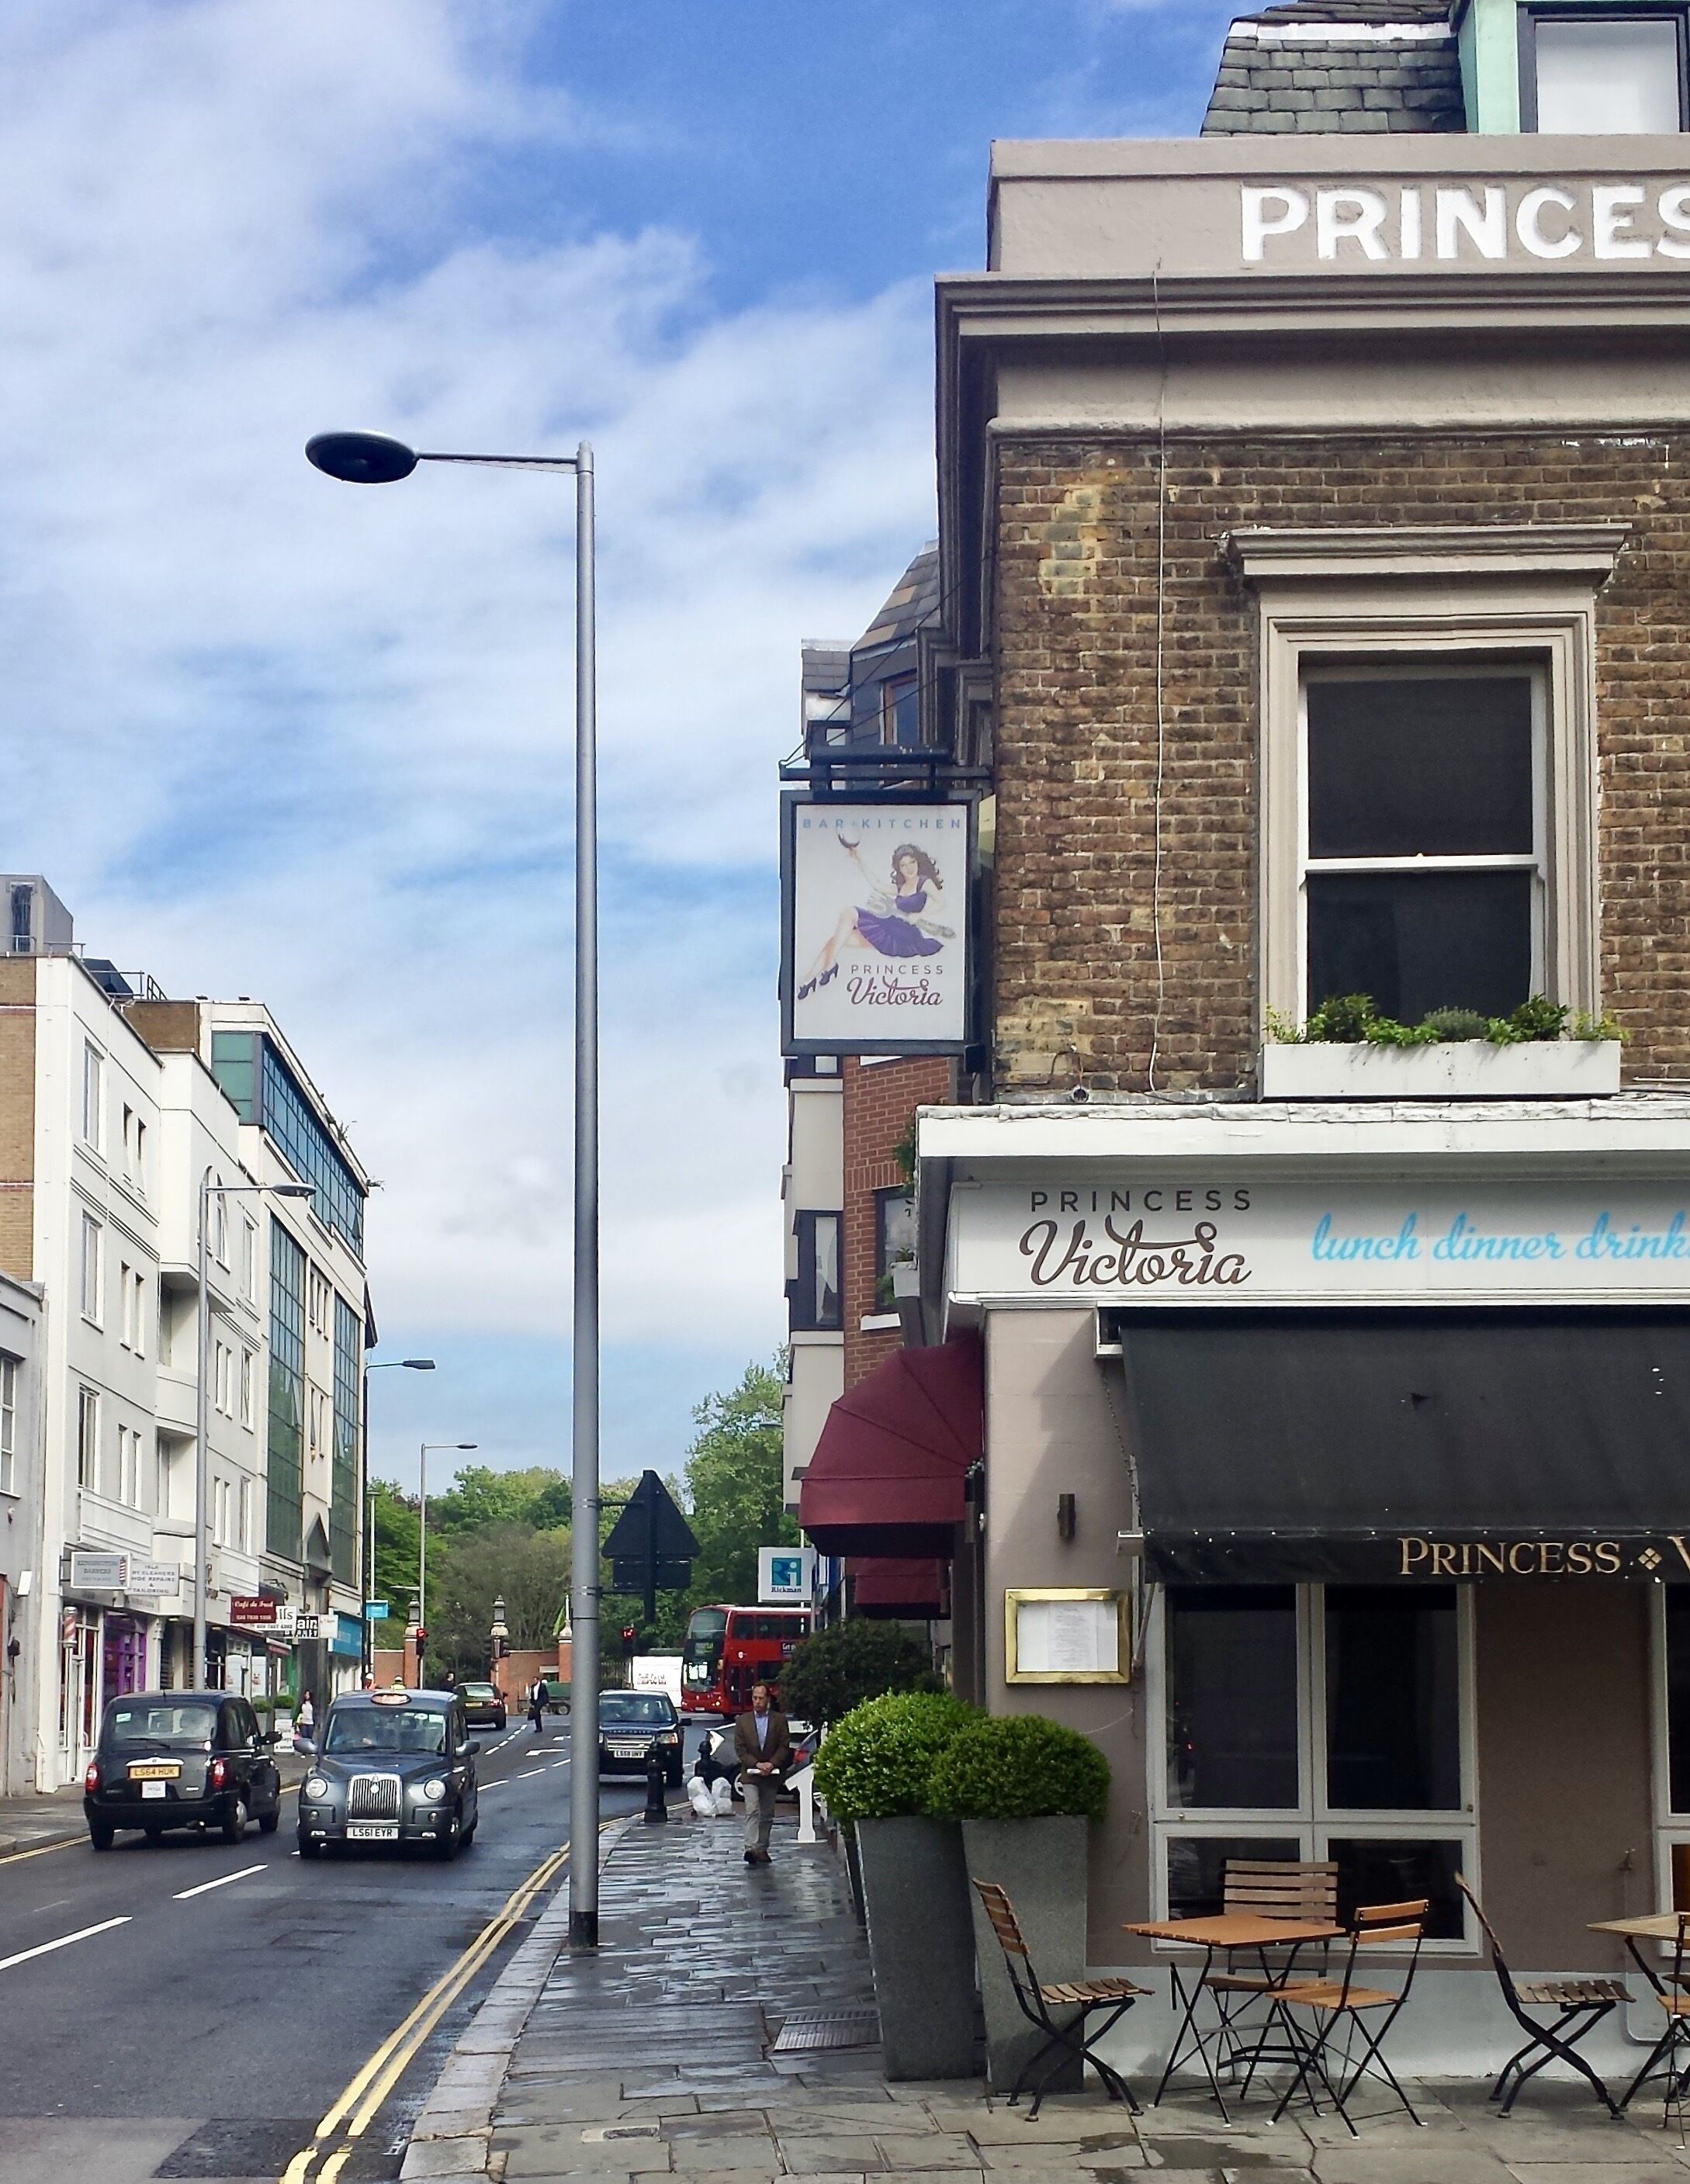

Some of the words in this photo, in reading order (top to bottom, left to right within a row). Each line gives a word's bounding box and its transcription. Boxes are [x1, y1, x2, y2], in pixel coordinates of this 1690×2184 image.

[802, 819, 845, 829] BAR
[861, 819, 961, 829] KITCHEN
[851, 964, 944, 974] PRINCESS
[846, 975, 944, 1005] Victoria
[1030, 1189, 1251, 1212] PRINCESS
[1312, 1211, 1422, 1262] lunch
[1433, 1210, 1568, 1261] dinner
[1575, 1210, 1690, 1260] drink
[1019, 1213, 1252, 1286] Victoria
[1397, 1537, 1621, 1576] PRINCESS
[352, 1828, 372, 1837] LS61
[375, 1828, 393, 1837] EYR
